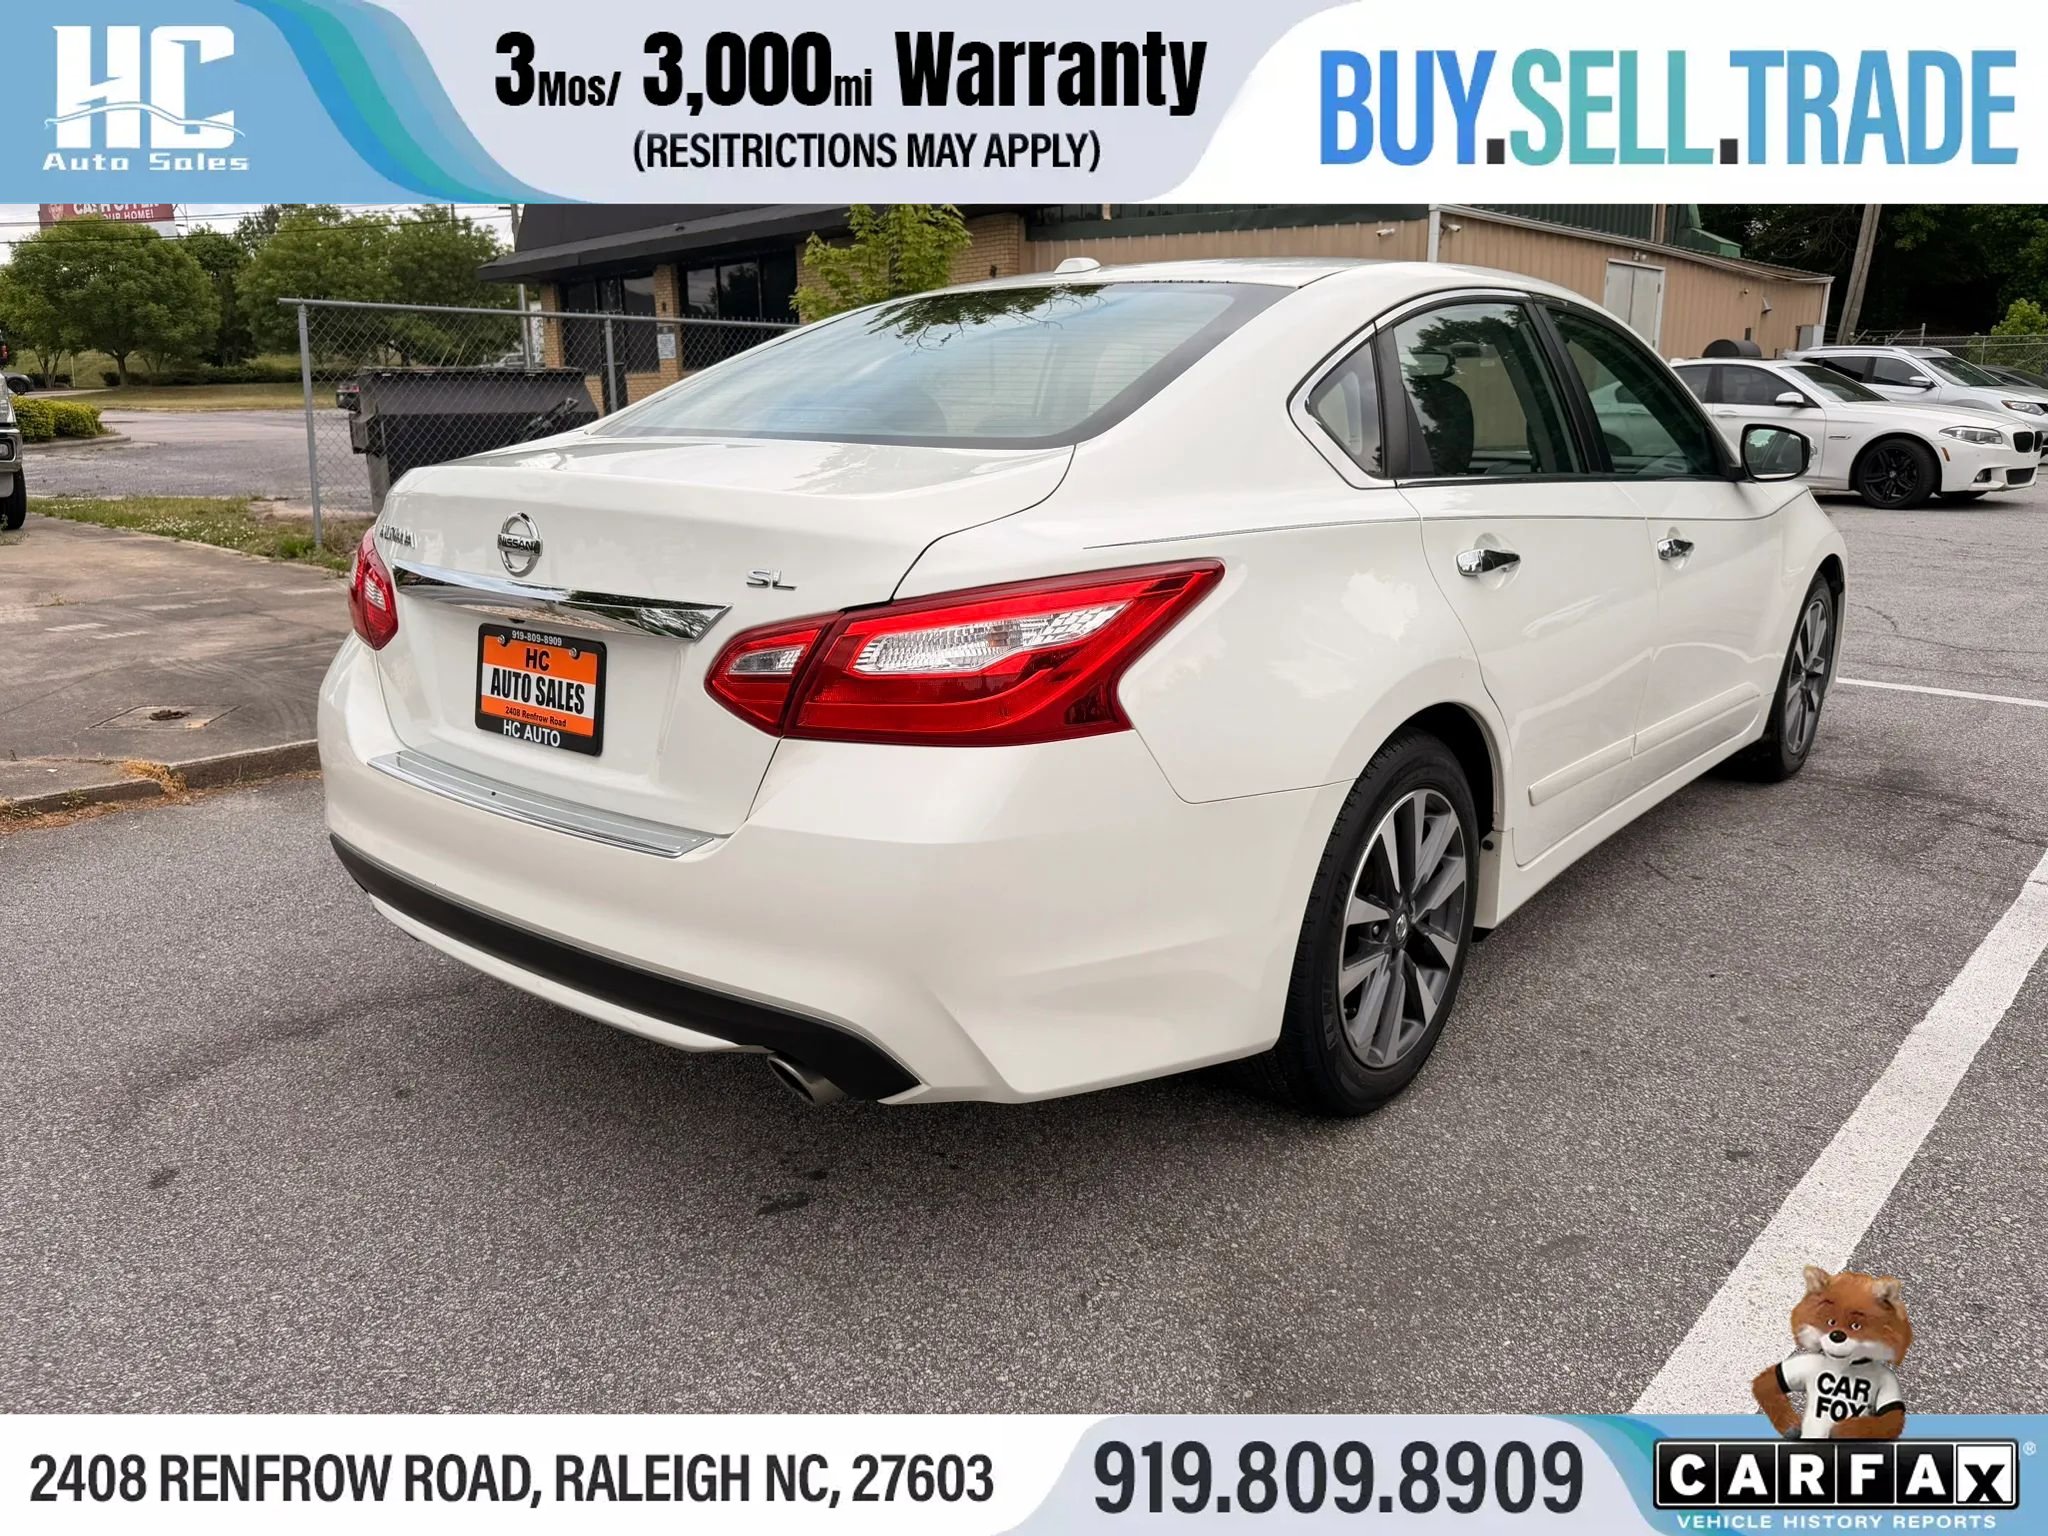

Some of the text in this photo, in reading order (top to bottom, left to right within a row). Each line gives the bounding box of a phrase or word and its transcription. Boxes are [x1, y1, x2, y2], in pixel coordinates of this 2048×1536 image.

[499, 535, 536, 552] NISSAN
[745, 569, 798, 591] SL
[511, 630, 562, 646] 919-809-8909
[525, 647, 550, 671] HC
[490, 668, 585, 715] AUTO SALES
[505, 706, 567, 728] 2408 Renfrow Road
[503, 719, 561, 747] HC AUTO
